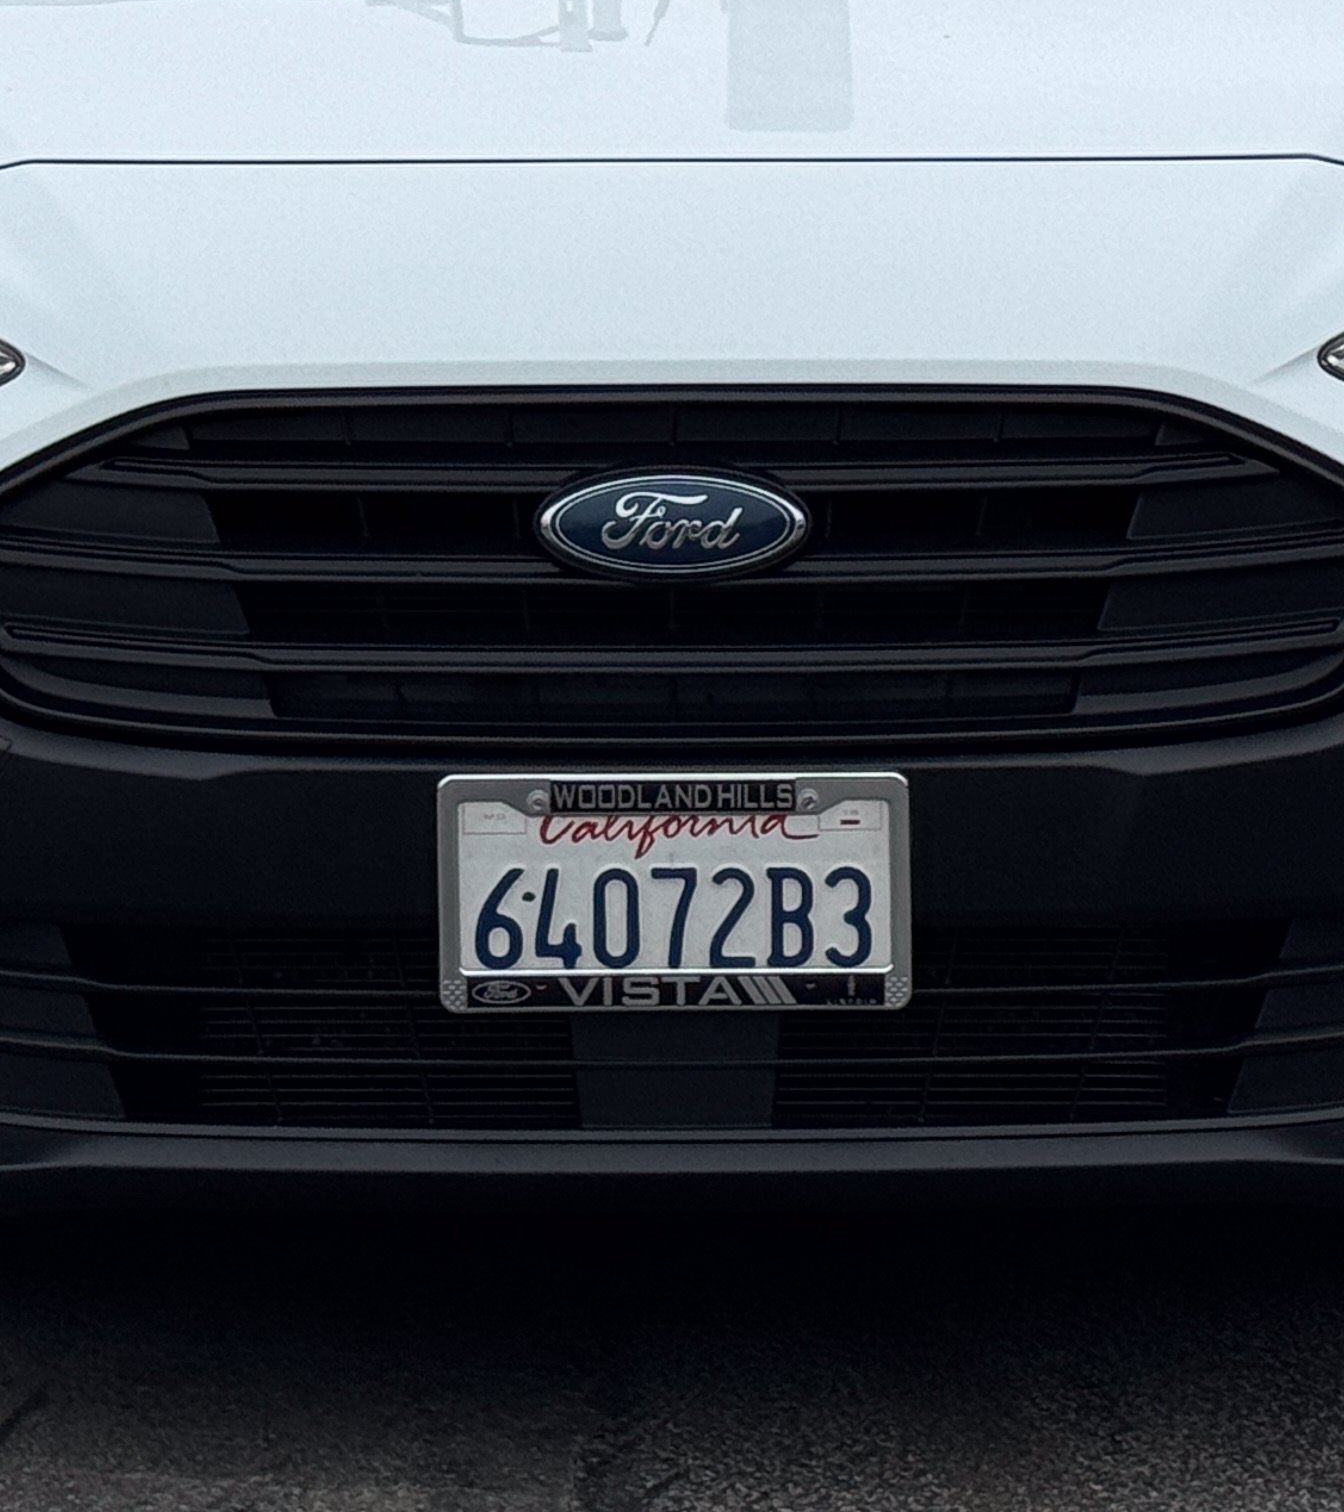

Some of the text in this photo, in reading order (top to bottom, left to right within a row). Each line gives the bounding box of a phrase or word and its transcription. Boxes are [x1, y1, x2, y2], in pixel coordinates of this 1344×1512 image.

[601, 491, 743, 550] Ford
[554, 783, 794, 810] WOODLAND HILLS
[539, 814, 821, 860] California
[474, 866, 873, 970] 64072B3
[557, 976, 748, 1007] VISTA
